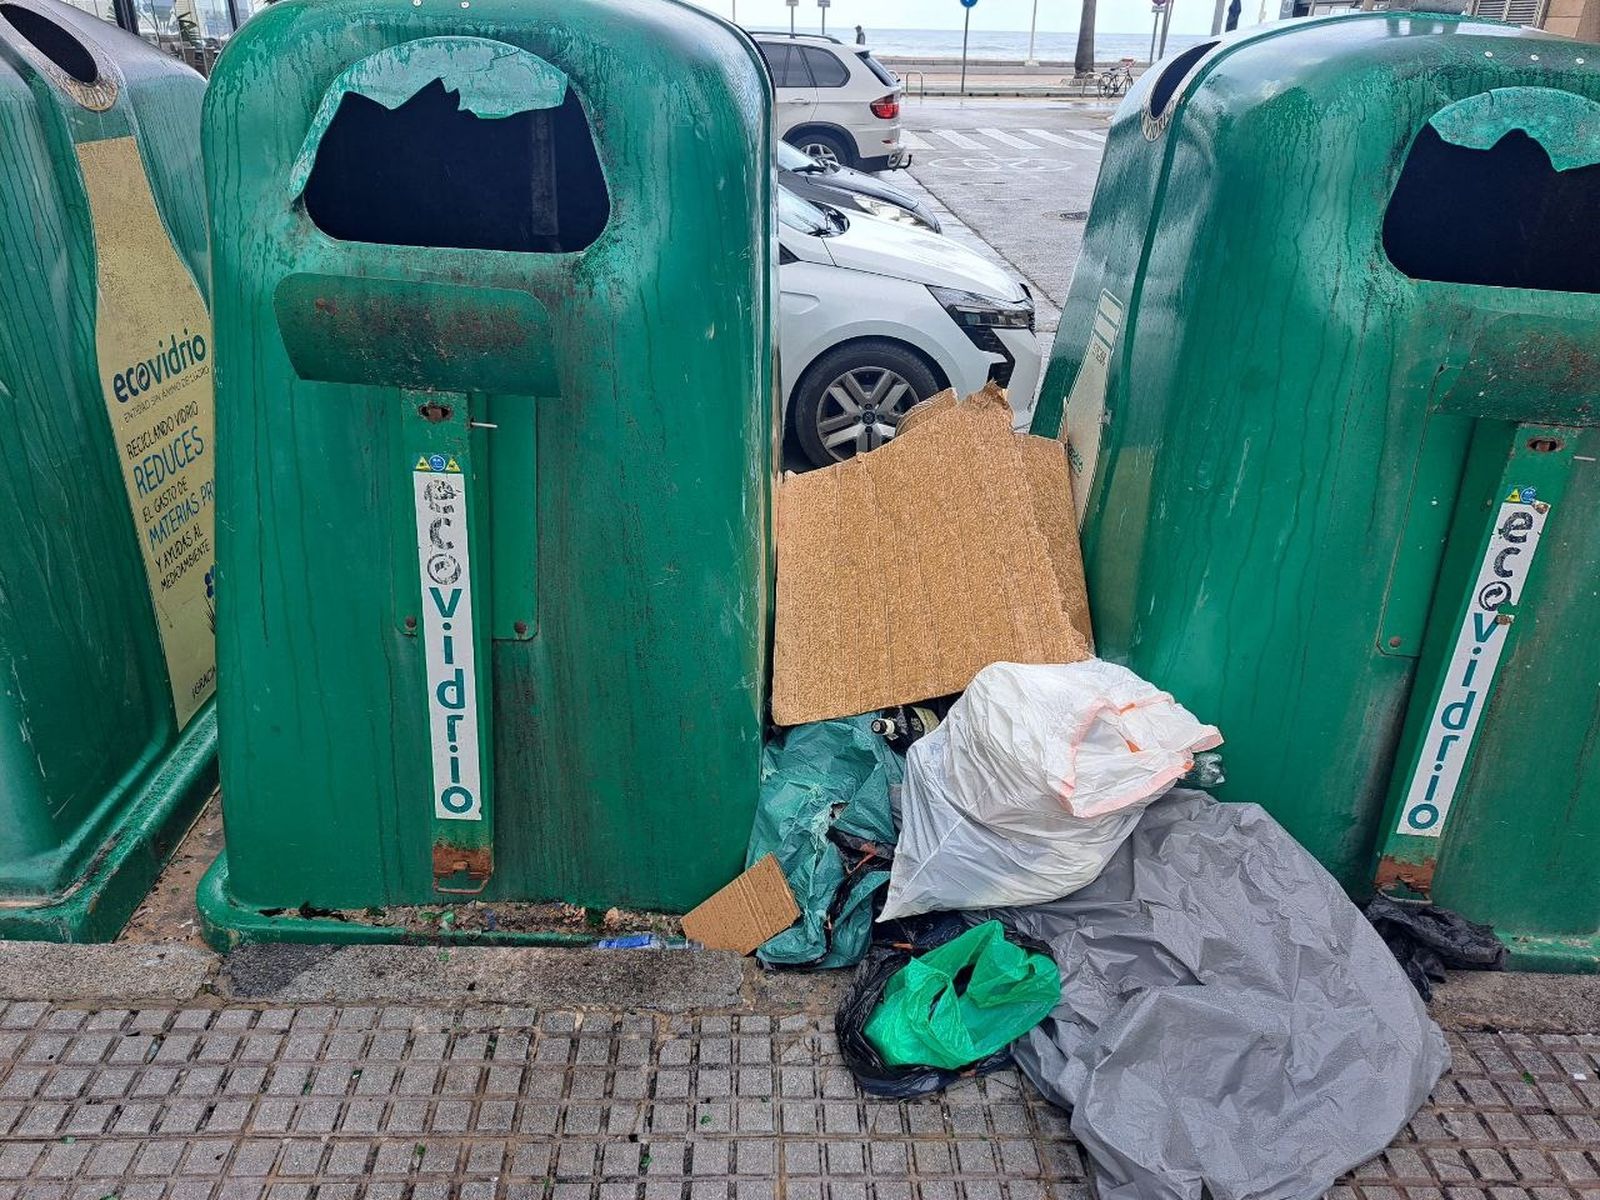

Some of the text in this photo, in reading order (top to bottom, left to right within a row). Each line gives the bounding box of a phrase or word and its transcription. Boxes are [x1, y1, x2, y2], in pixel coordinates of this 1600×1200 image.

[113, 327, 206, 403] ecovidrio
[126, 401, 198, 460] RECICLANDO VIDRIO
[133, 425, 204, 499] REDUCES
[142, 475, 189, 524] EL GASTO DE
[149, 492, 200, 552] MATERIAS
[155, 522, 204, 573] Y AYUDAS AL
[423, 478, 474, 814] ecovidrio
[1407, 510, 1534, 830] ecovidrio
